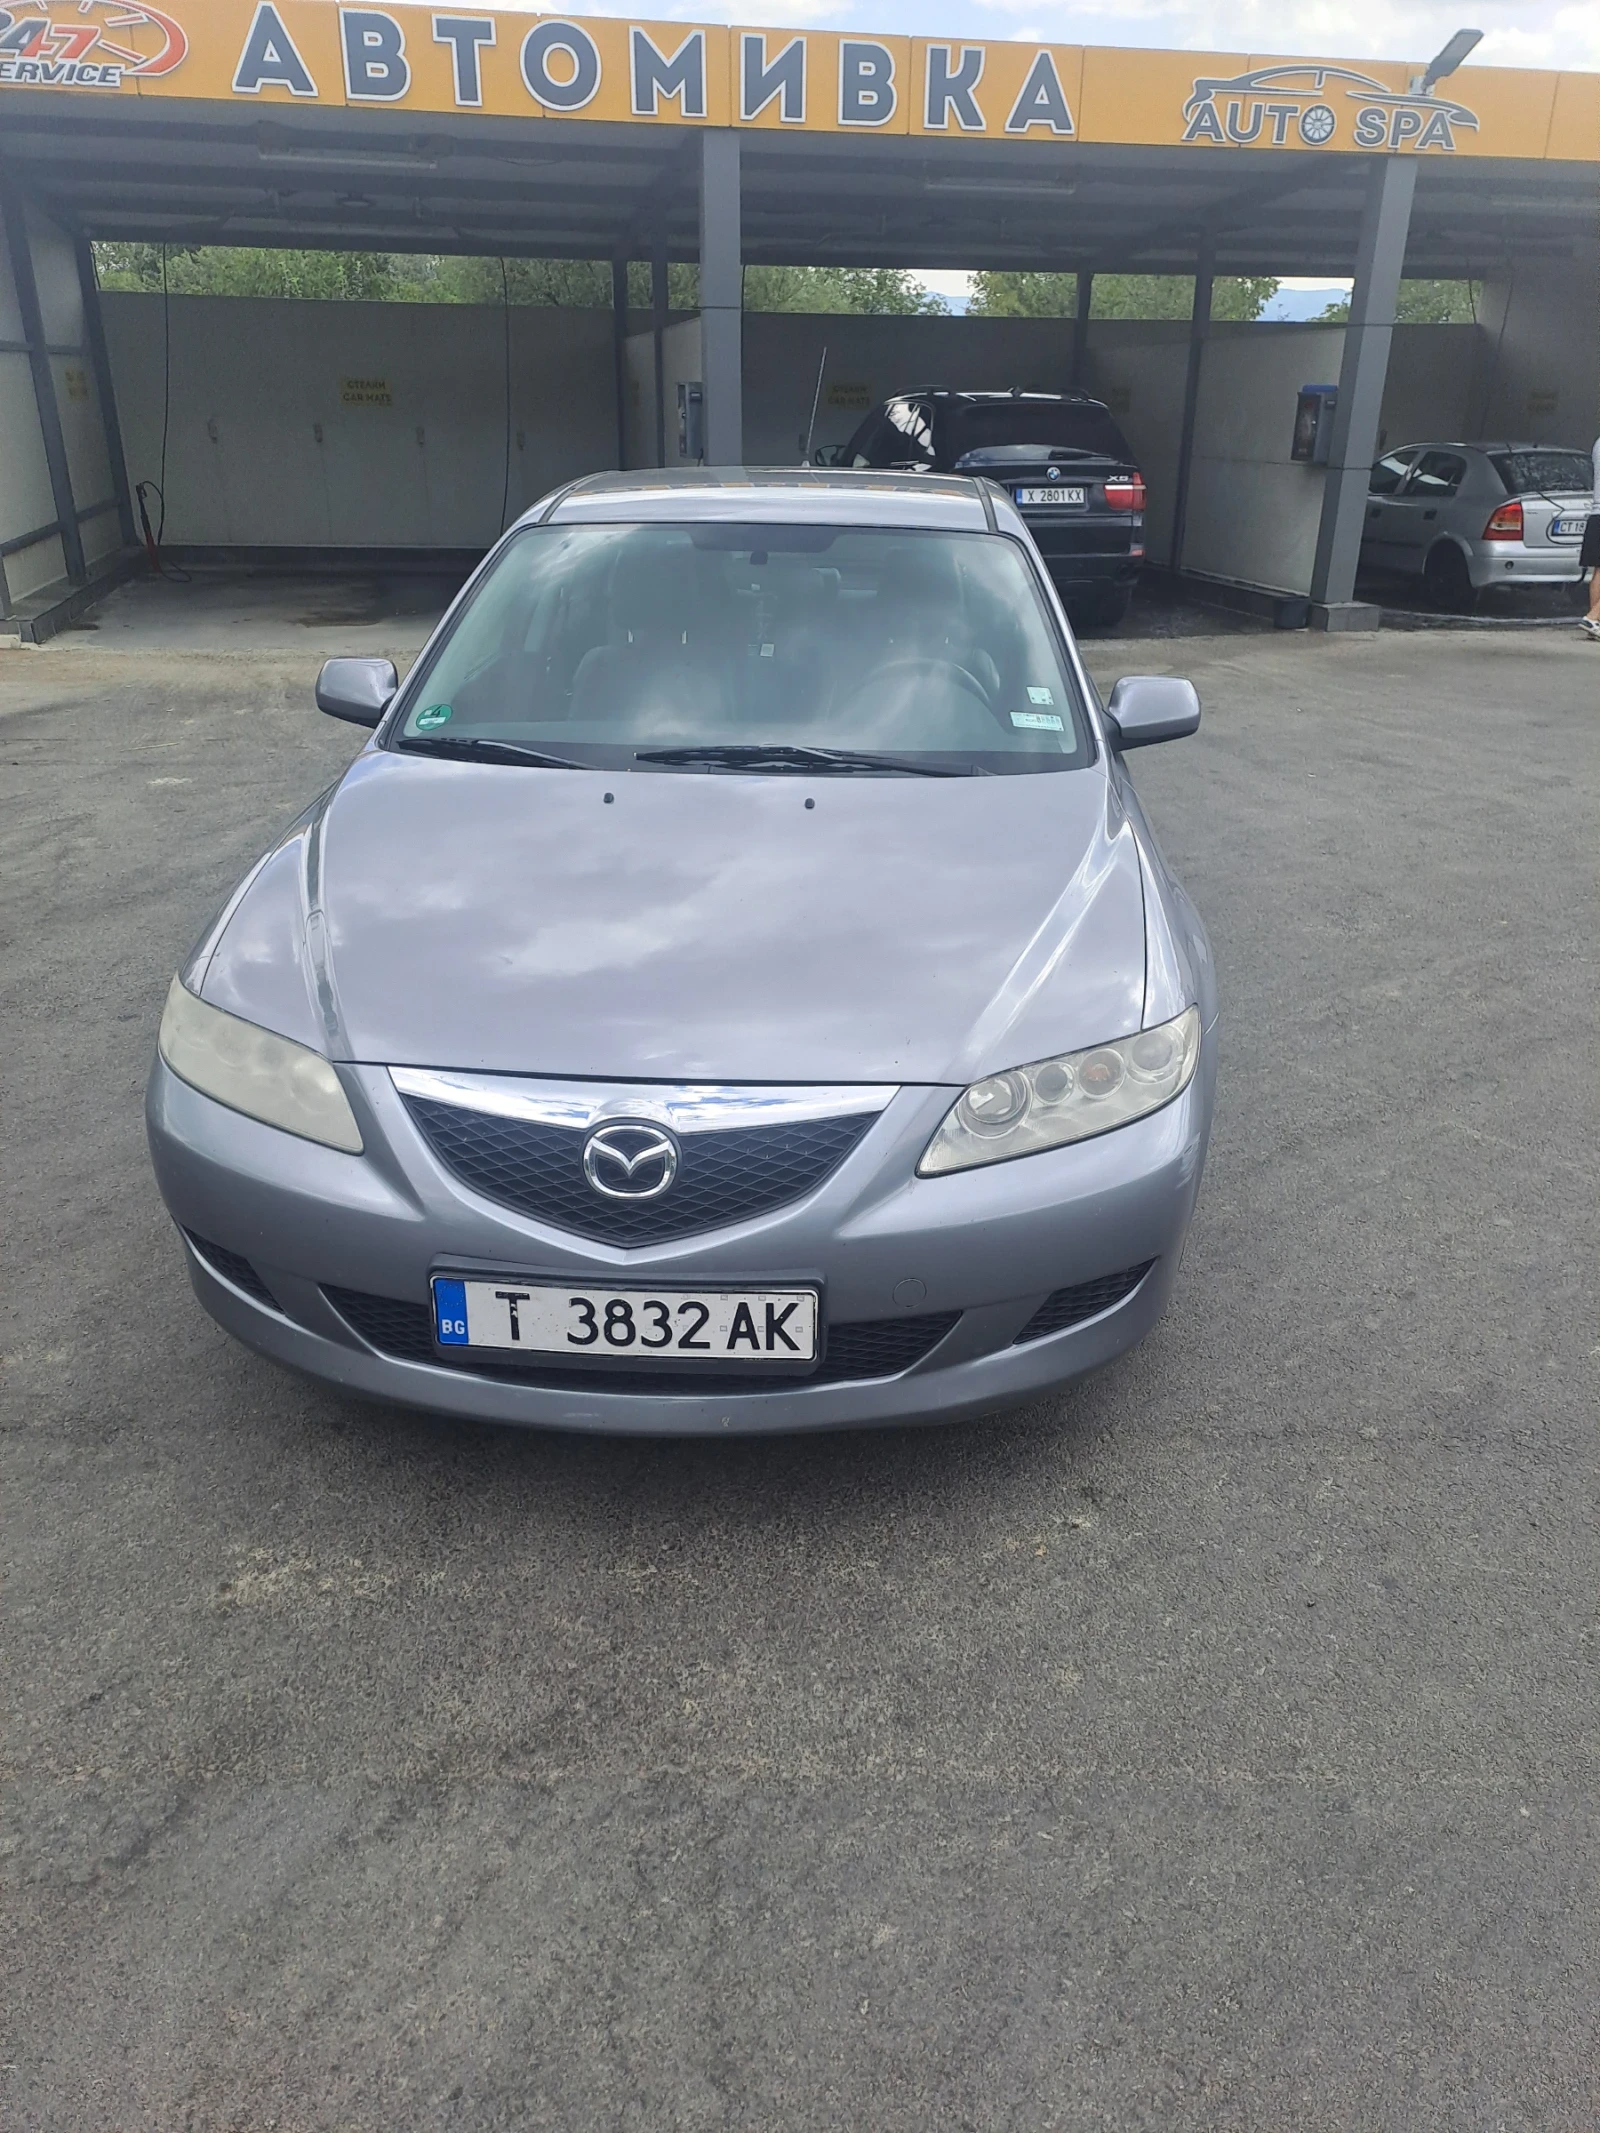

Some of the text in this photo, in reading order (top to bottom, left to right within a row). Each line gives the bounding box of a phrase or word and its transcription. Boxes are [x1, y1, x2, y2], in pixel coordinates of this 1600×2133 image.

[0, 60, 124, 86] ERVICE
[232, 1, 1075, 135] АВТОМИВКА
[1181, 101, 1456, 151] AUTO SPA
[1028, 490, 1035, 502] X
[1041, 490, 1065, 502] 2801
[1068, 489, 1082, 502] KX
[1560, 522, 1585, 532] CT 18
[441, 1319, 465, 1335] BG
[495, 1290, 801, 1351] T 3832 AK
